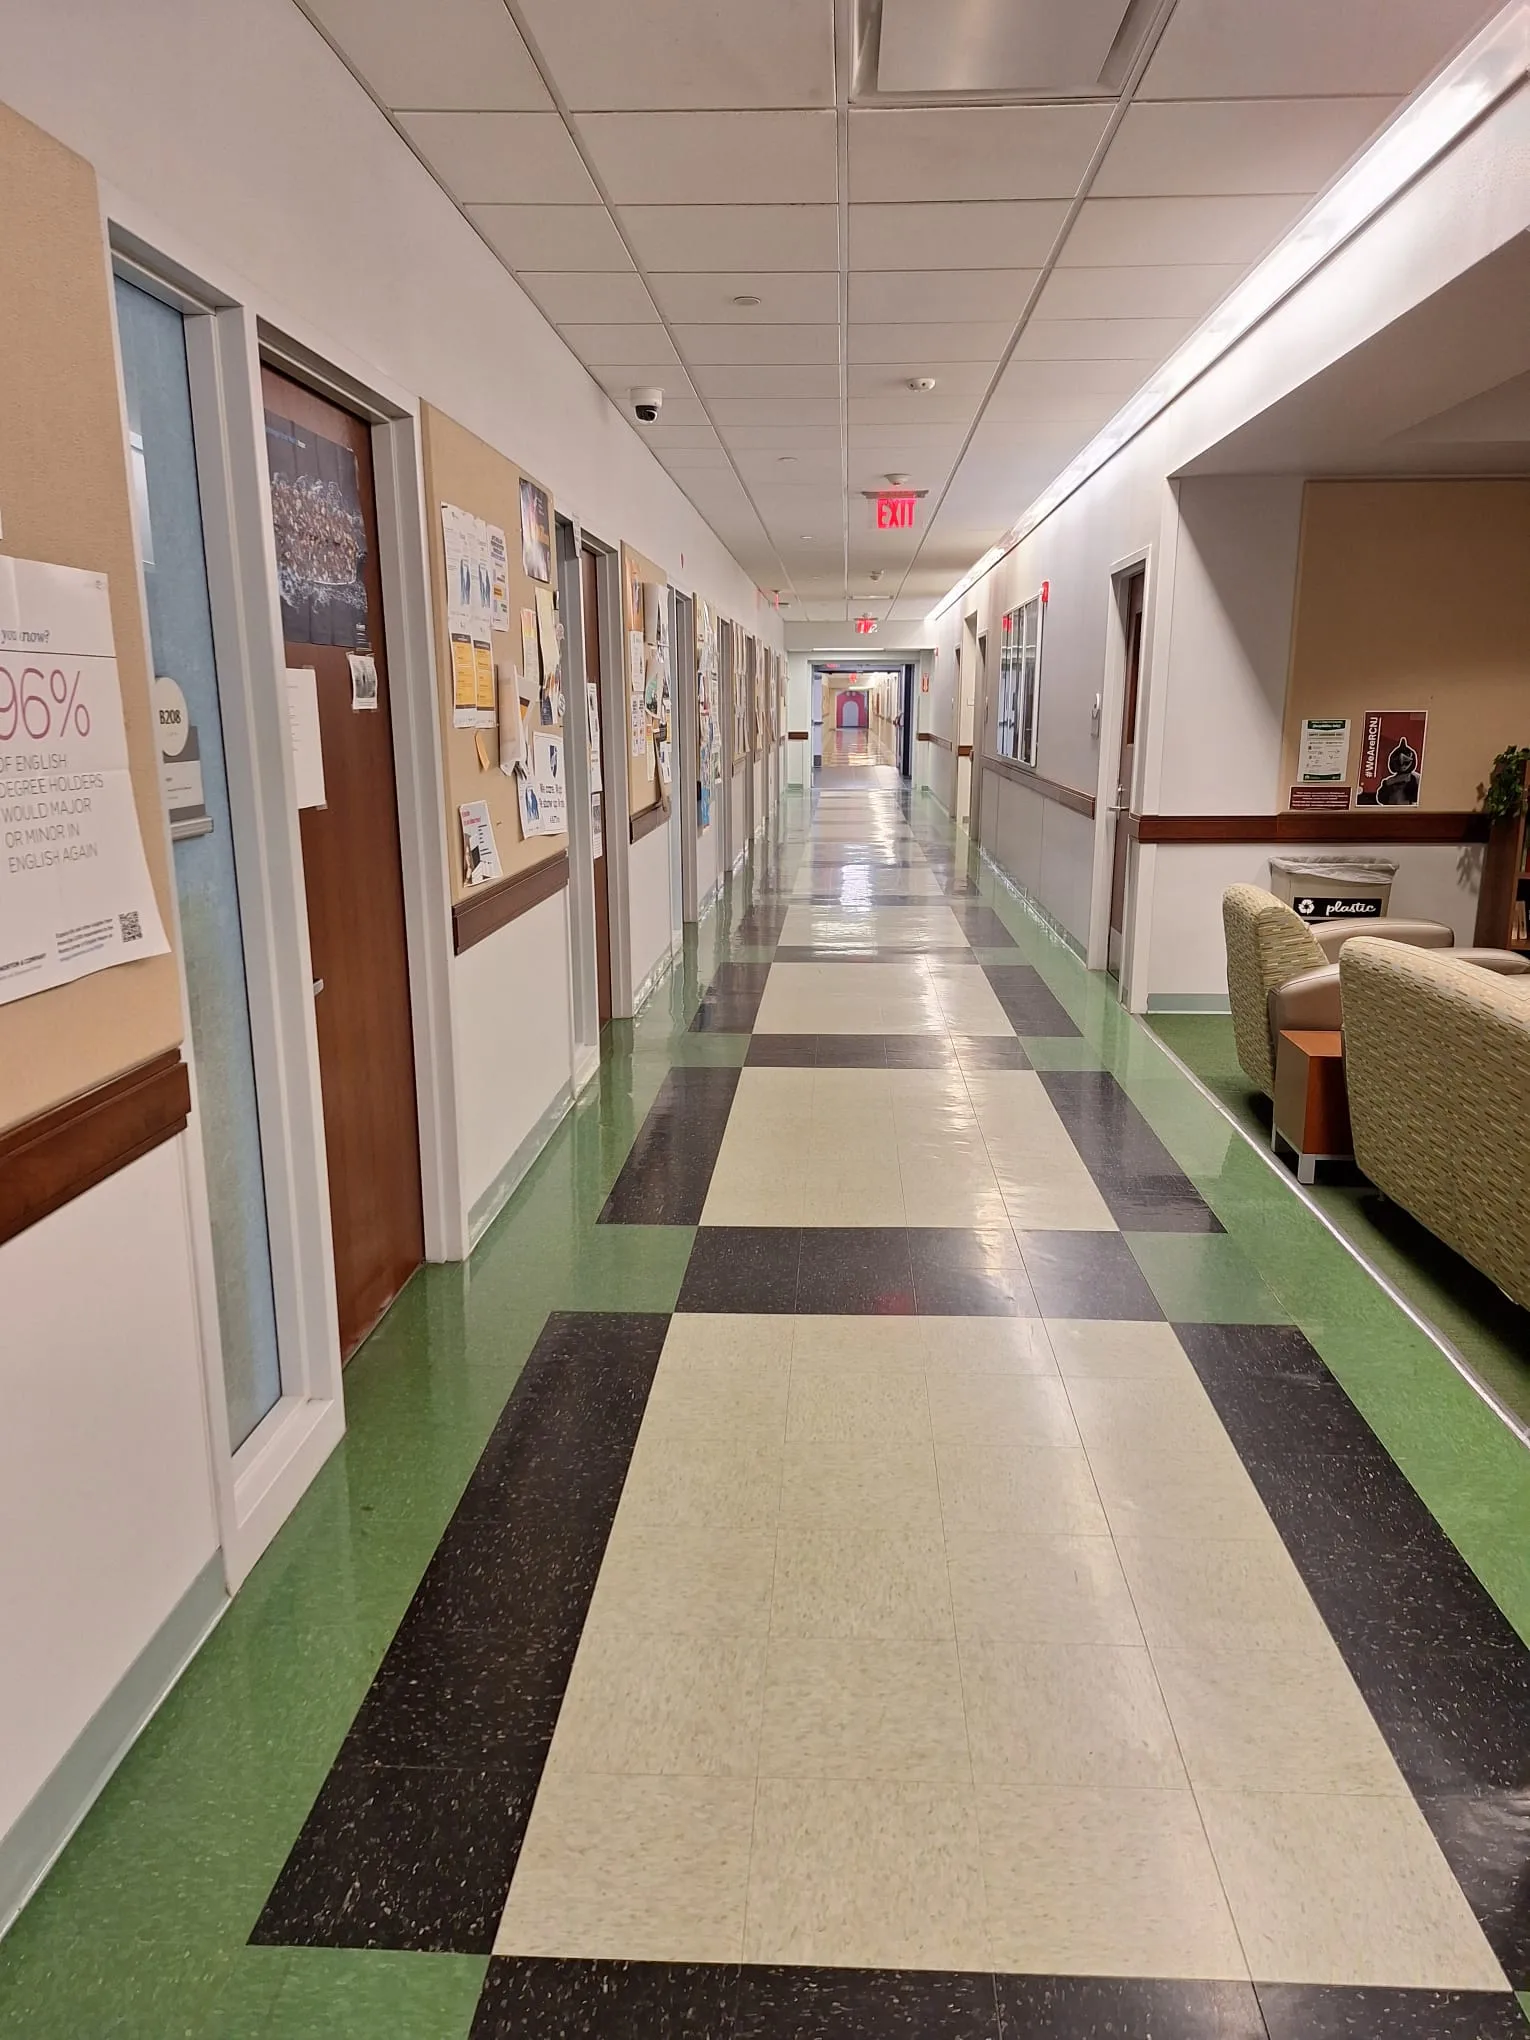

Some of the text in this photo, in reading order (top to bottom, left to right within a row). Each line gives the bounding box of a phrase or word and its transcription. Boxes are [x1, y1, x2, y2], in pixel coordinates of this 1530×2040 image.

[877, 499, 916, 529] EXIT
[1, 630, 50, 644] you now?
[0, 667, 90, 741] 96%
[159, 709, 182, 725] B208
[1365, 716, 1379, 778] #WeAreRCNJ
[15, 753, 68, 772] ENGLISH
[50, 773, 104, 792] HOLDERS
[1, 797, 92, 823] WOULD MAJOR
[5, 822, 80, 848] OR MINOR IN
[8, 842, 99, 874] ENGLISH AGAIN
[1325, 900, 1377, 917] plastic
